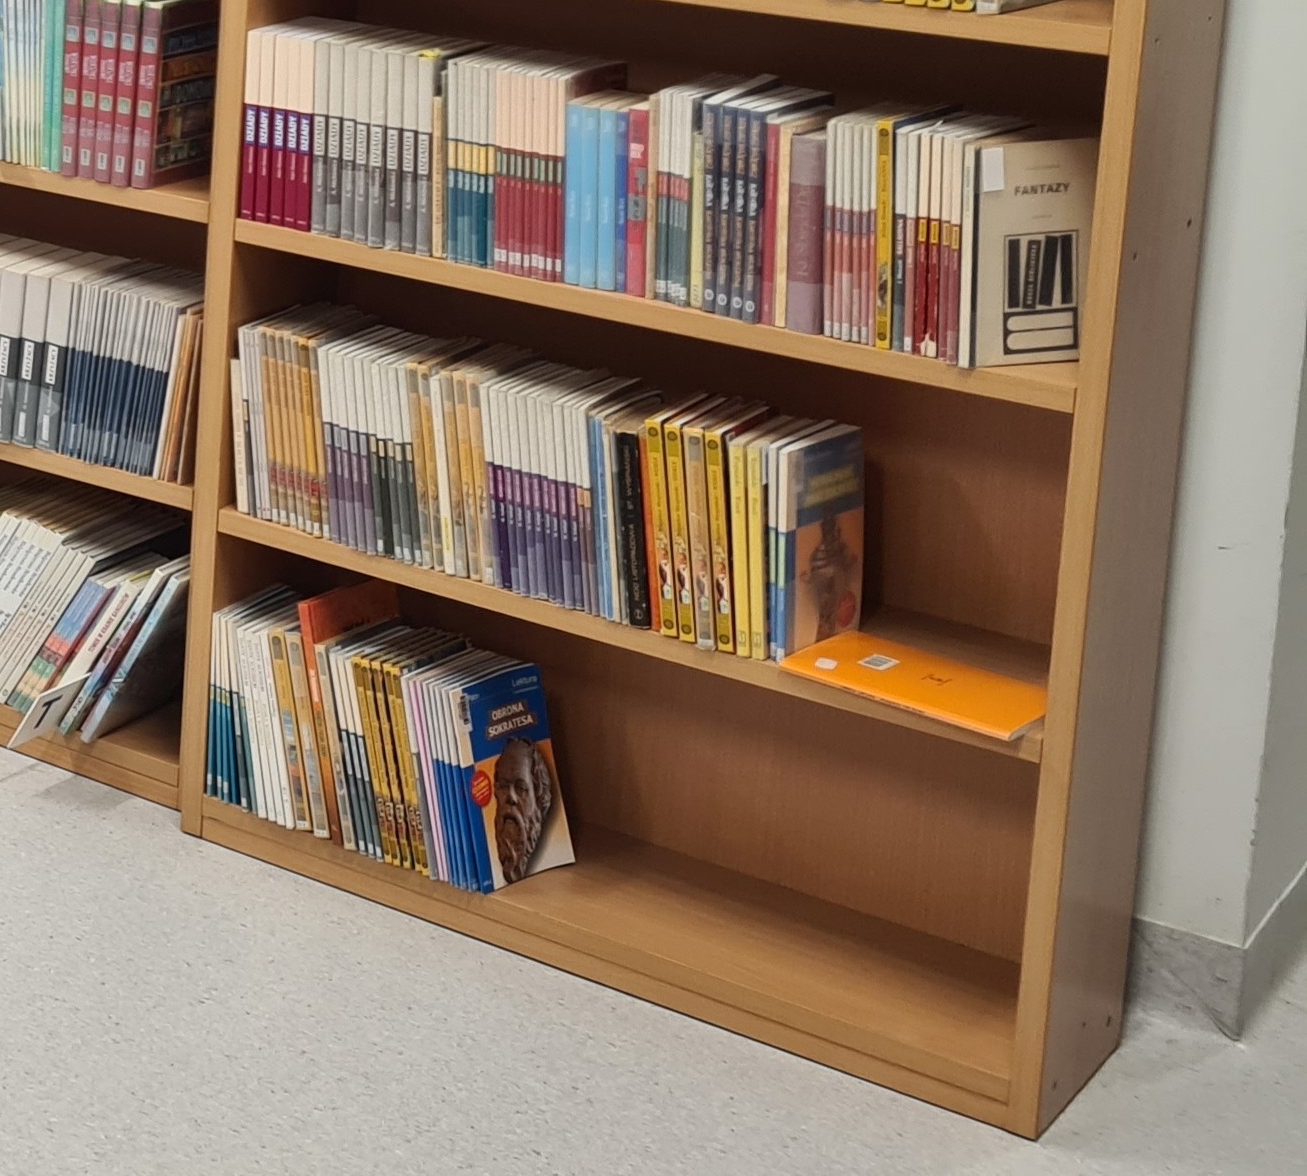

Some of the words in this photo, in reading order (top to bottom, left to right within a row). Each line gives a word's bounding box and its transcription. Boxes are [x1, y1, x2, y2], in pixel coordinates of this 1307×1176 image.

[246, 110, 255, 141] DZIADY
[259, 112, 268, 143] DZIADY
[275, 114, 284, 146] DZIADY
[288, 116, 297, 148] DZIADY
[301, 119, 309, 151] DZIADY
[1014, 183, 1070, 196] FANTAZY
[512, 676, 538, 687] Lektura
[33, 694, 64, 730] T
[488, 714, 534, 737] SOKRATESA
[491, 702, 524, 721] OBRONA
